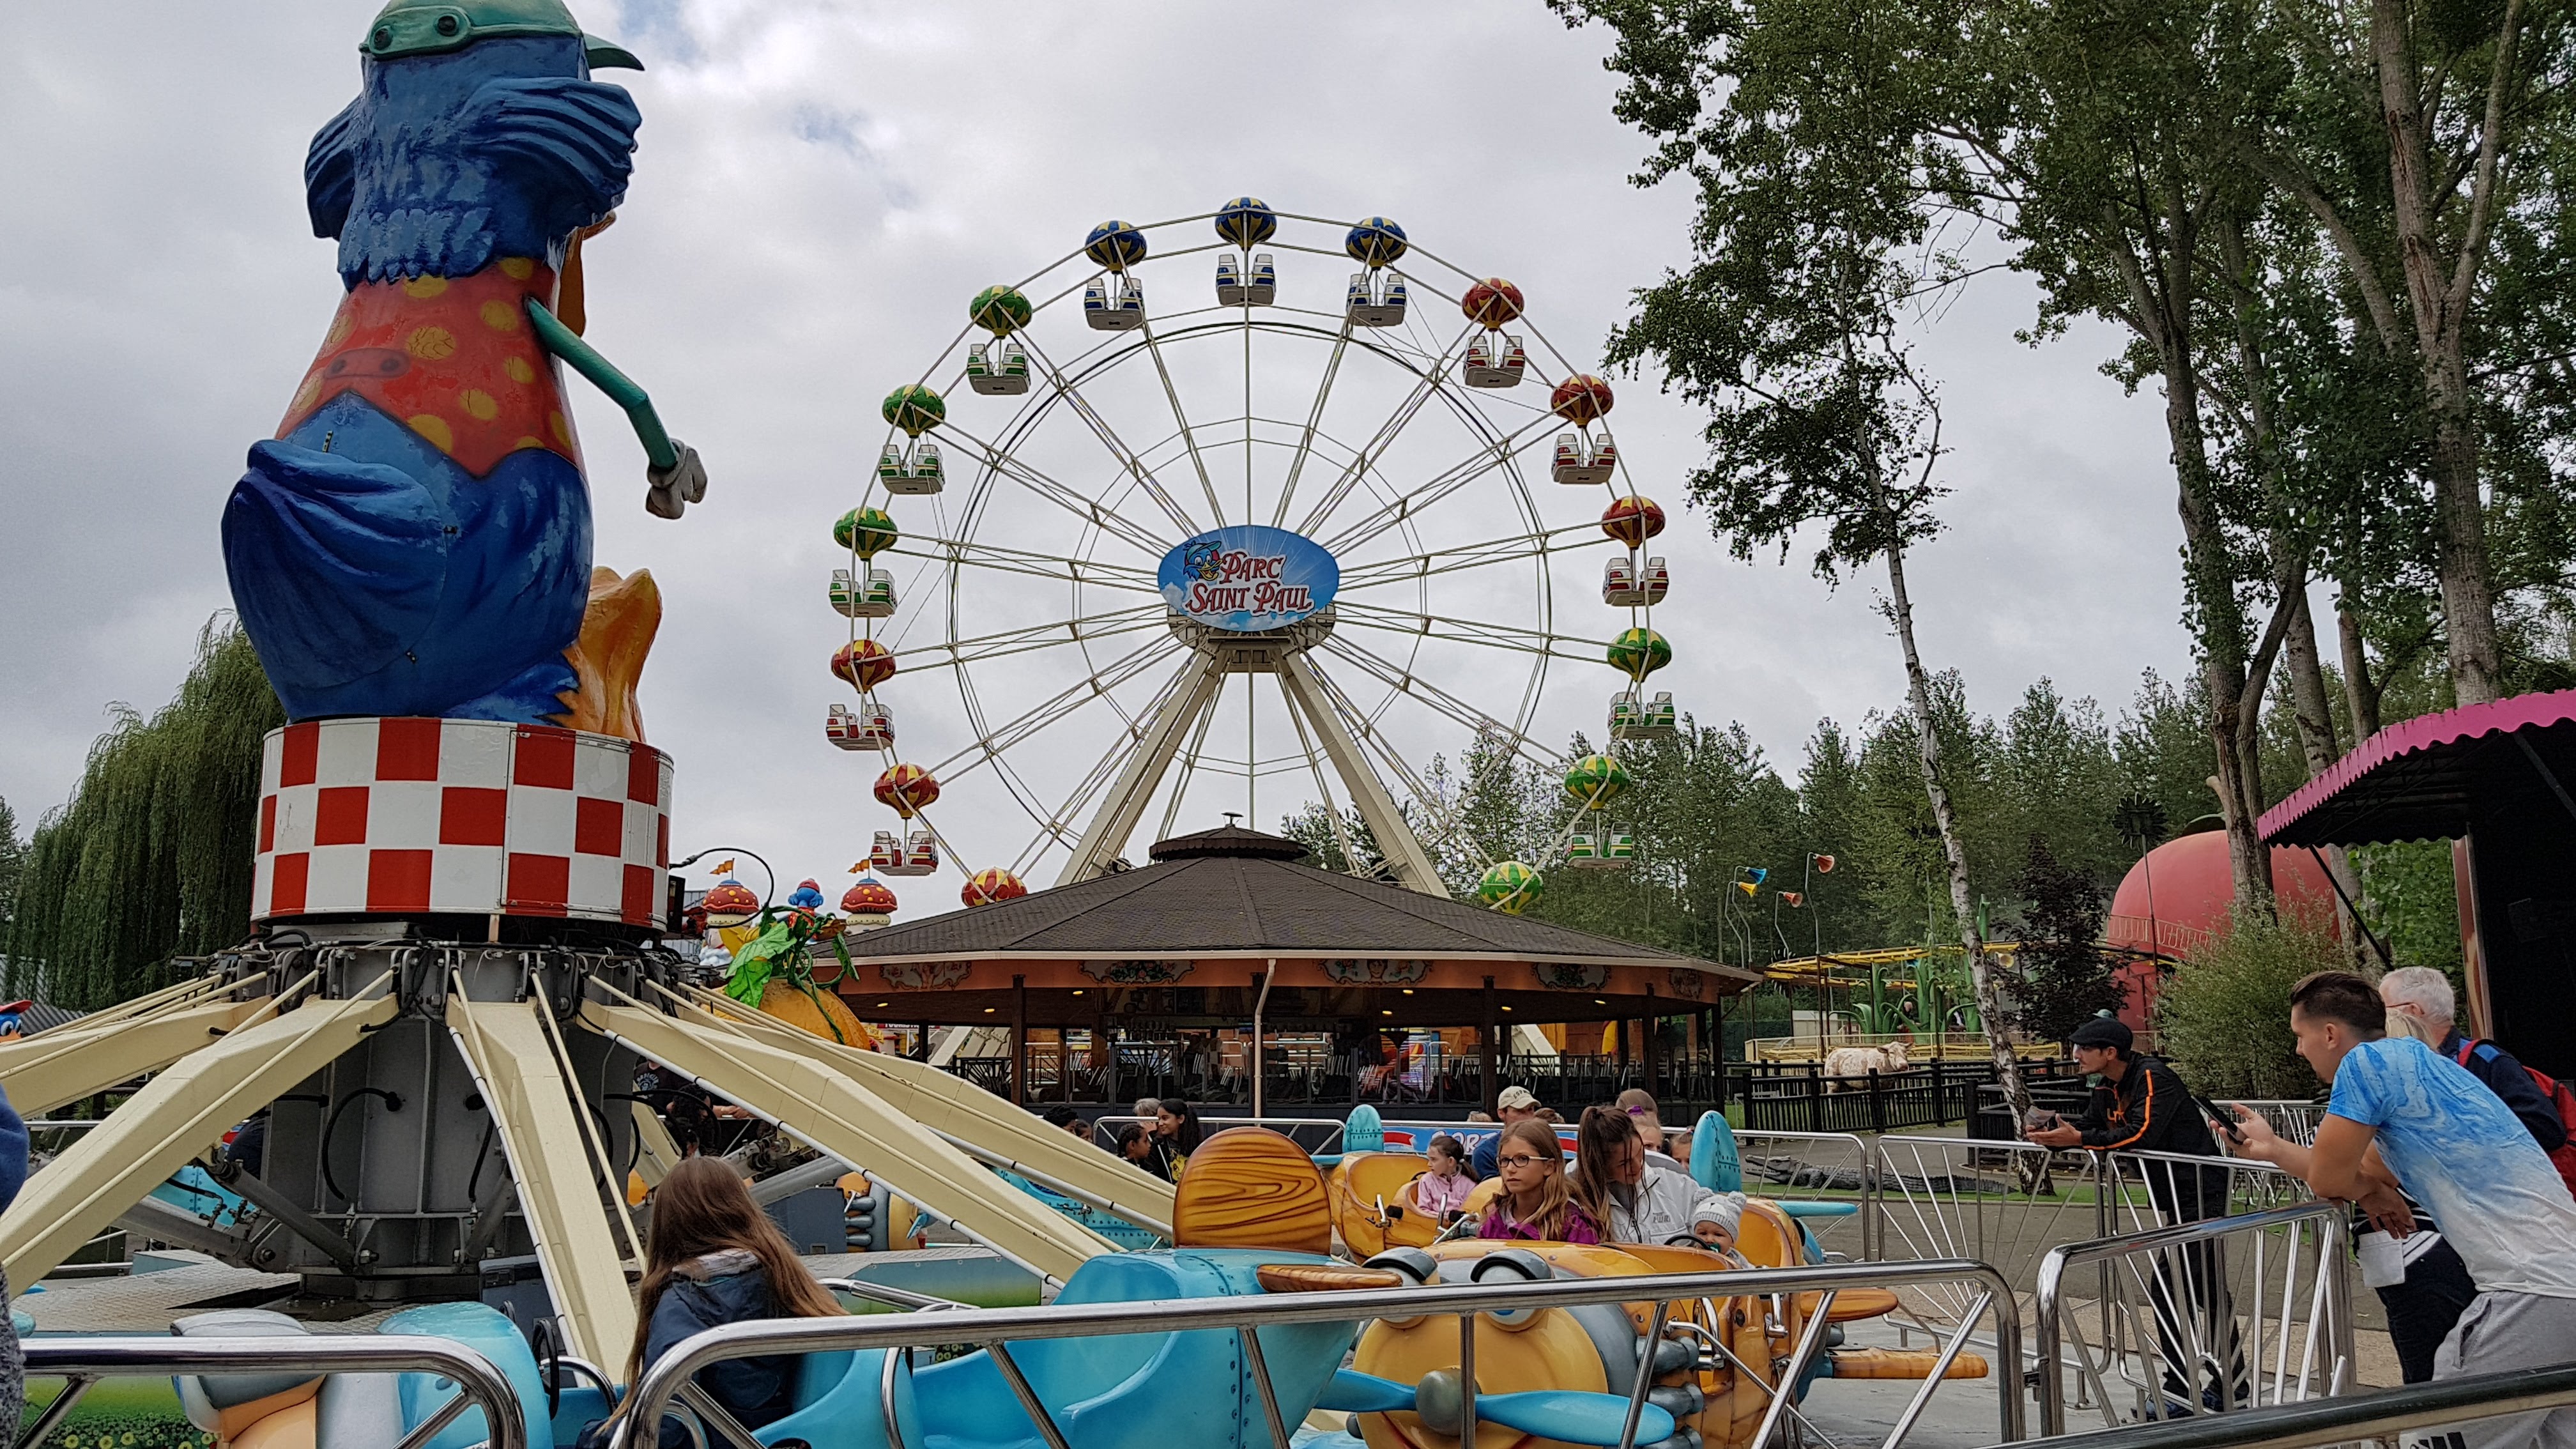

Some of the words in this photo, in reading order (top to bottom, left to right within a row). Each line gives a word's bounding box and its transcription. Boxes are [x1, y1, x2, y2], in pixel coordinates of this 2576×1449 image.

[1220, 551, 1284, 584] PARC
[1185, 583, 1250, 613] SAINT
[1253, 580, 1312, 613] PAUL
